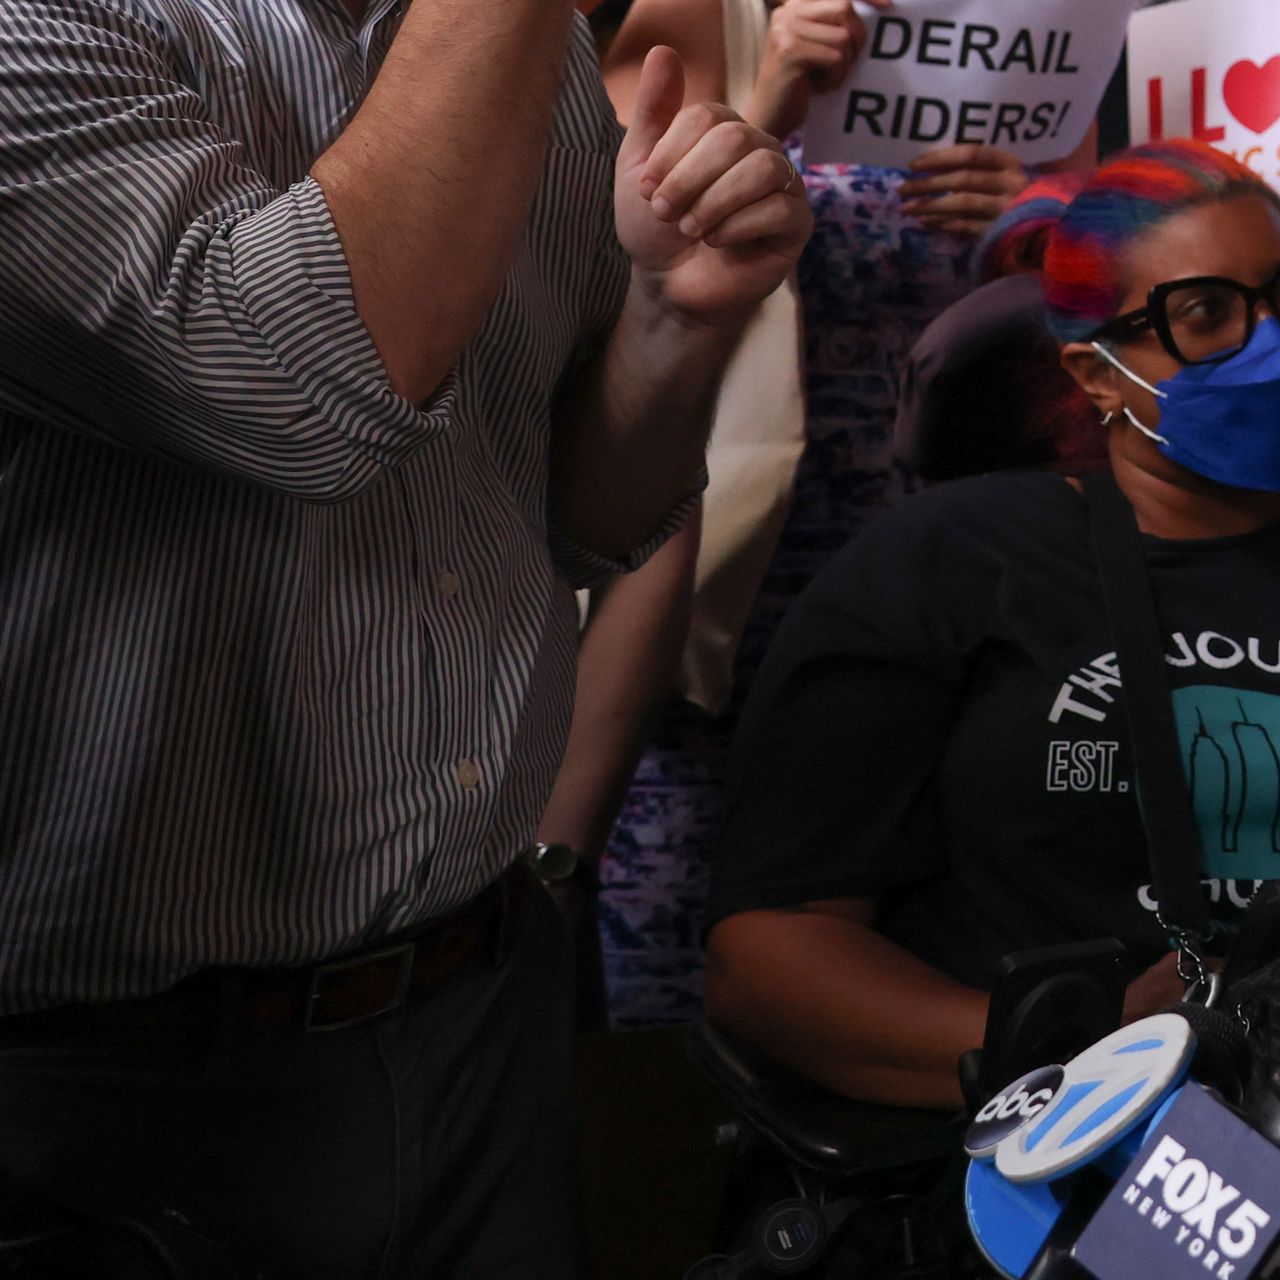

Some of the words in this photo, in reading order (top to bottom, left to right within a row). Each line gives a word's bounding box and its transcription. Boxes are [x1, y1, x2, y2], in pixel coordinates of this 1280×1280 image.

[870, 15, 1079, 74] DERAIL
[843, 89, 1072, 147] RIDERS!
[1147, 77, 1163, 142] I
[1046, 740, 1129, 793] EST.
[974, 1082, 1054, 1124] abc
[1123, 1183, 1171, 1230] NEW
[1175, 1228, 1237, 1280] YORK
